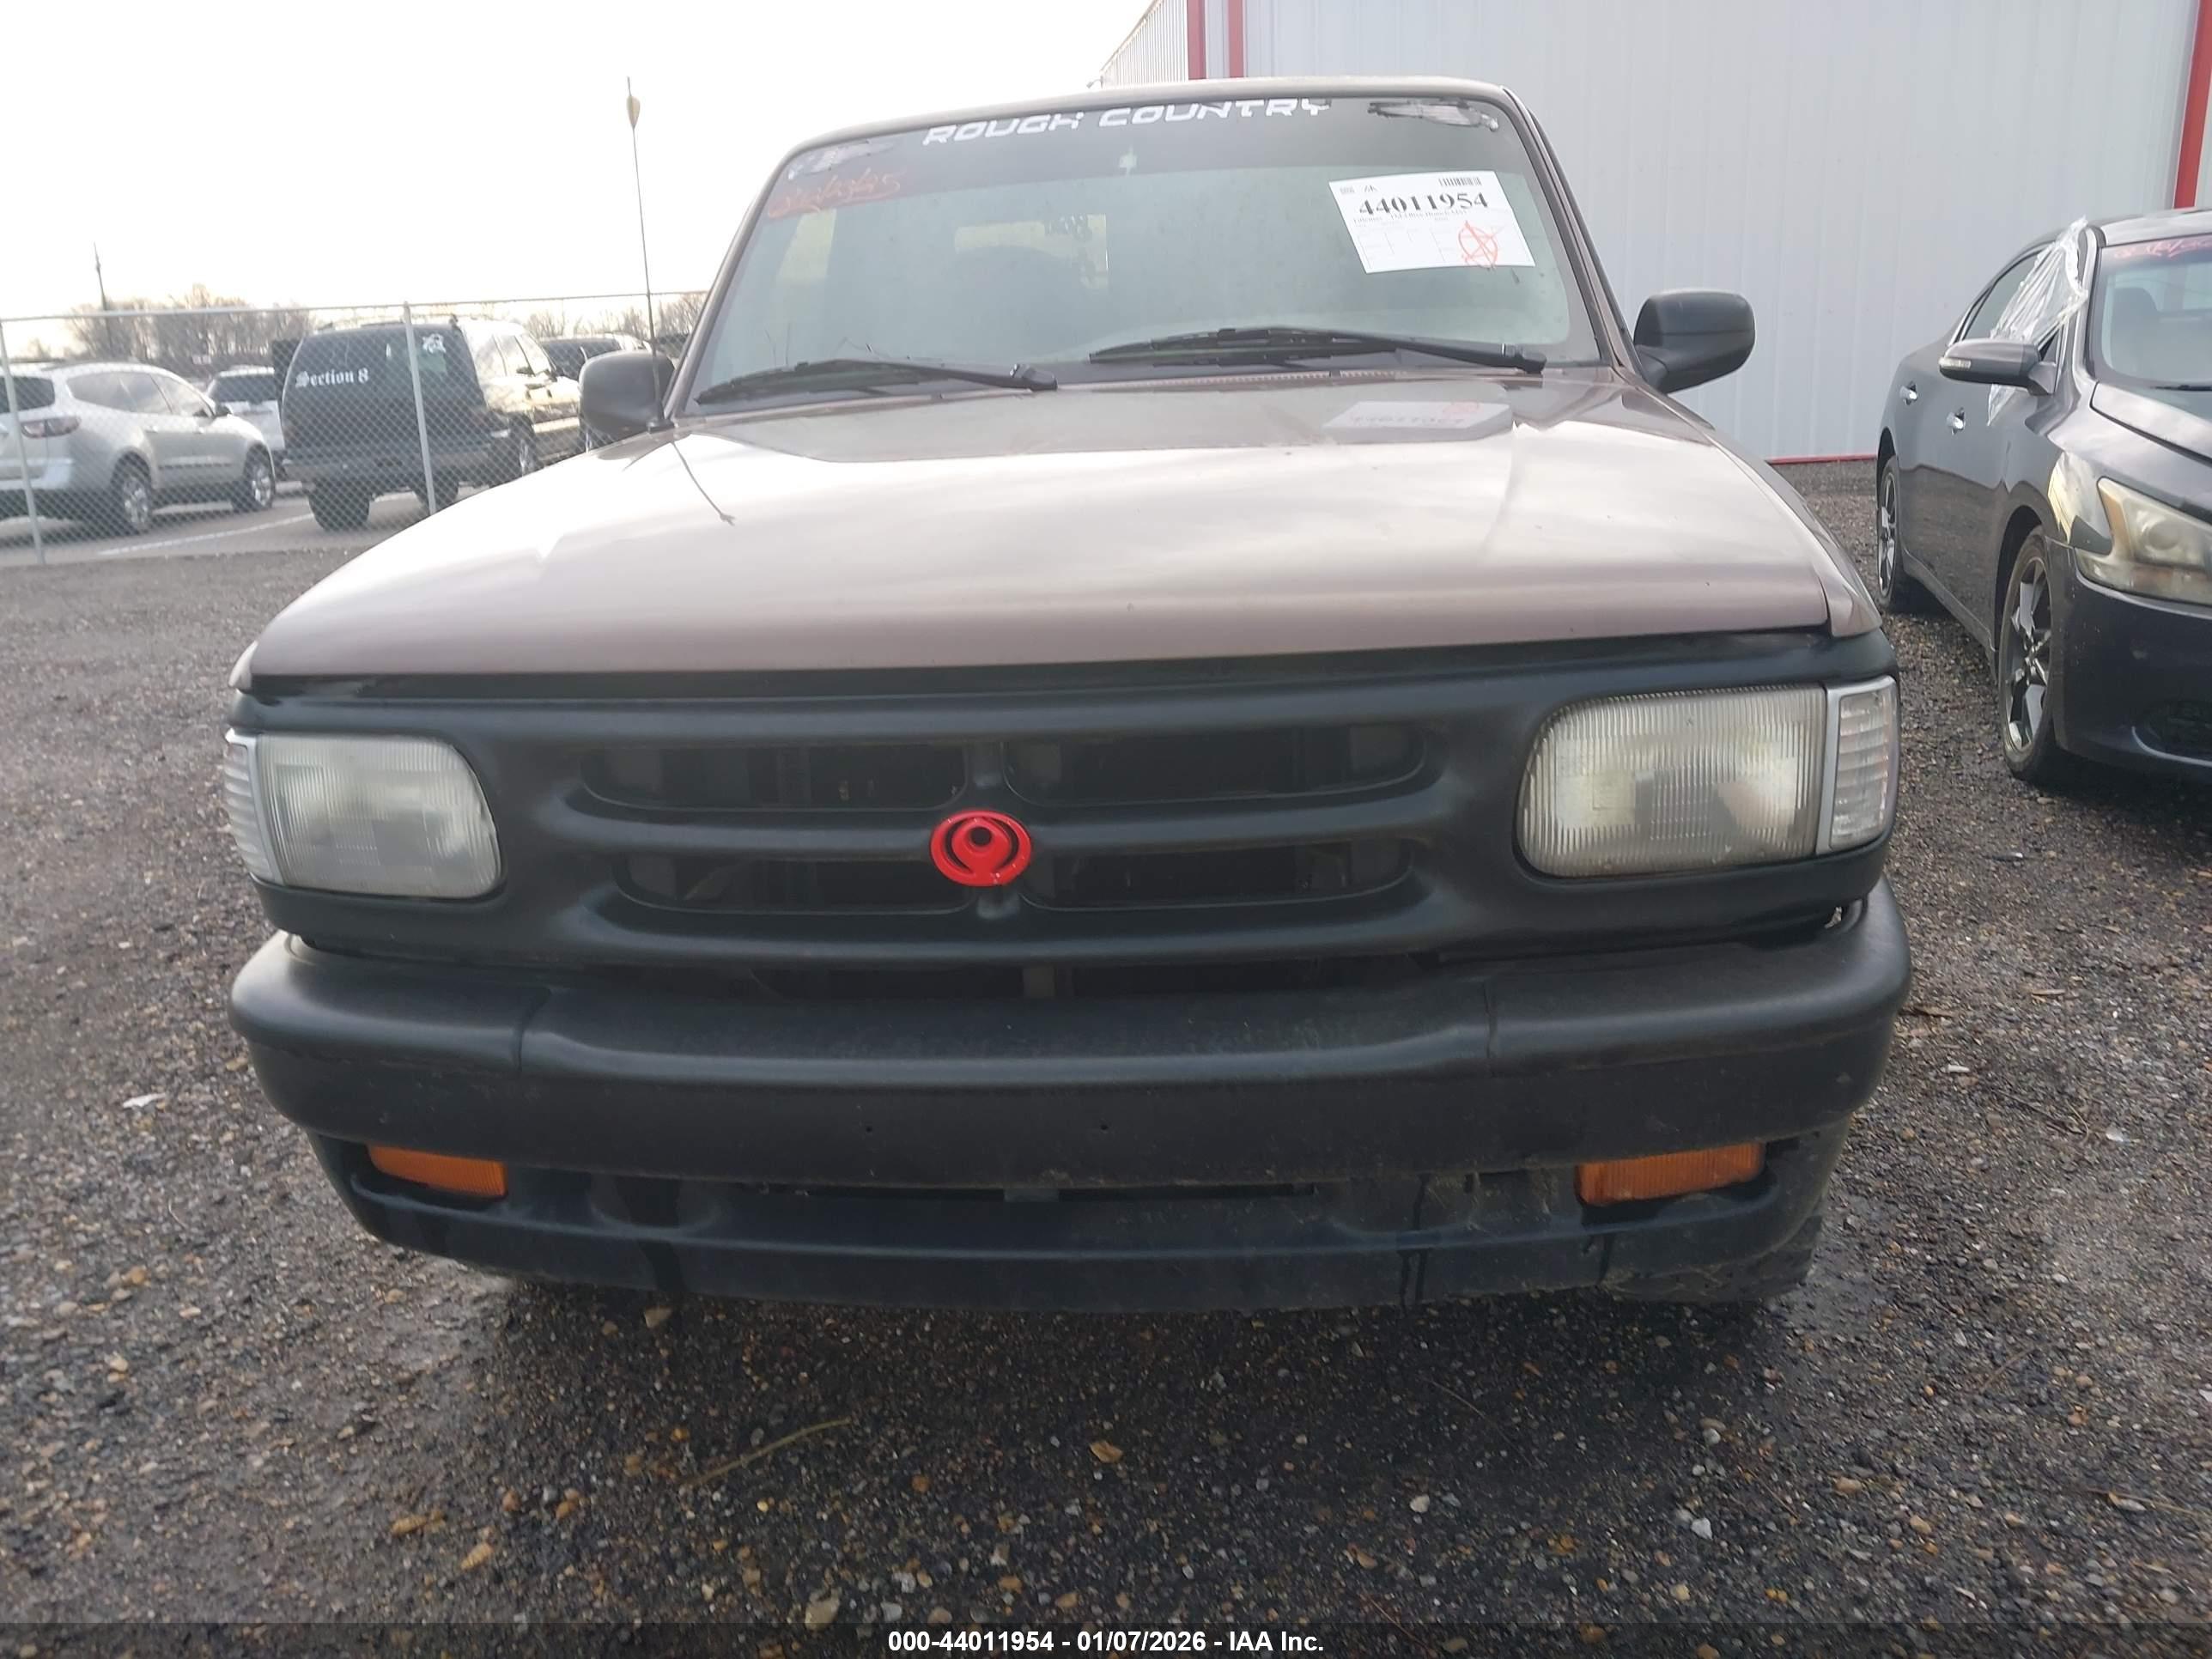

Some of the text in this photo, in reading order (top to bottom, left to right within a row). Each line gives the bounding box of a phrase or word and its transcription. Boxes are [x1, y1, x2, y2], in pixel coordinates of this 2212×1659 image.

[922, 98, 1331, 145] ROUGH COUNTRY
[1359, 192, 1488, 216] 44011954
[295, 367, 369, 388] Section 8
